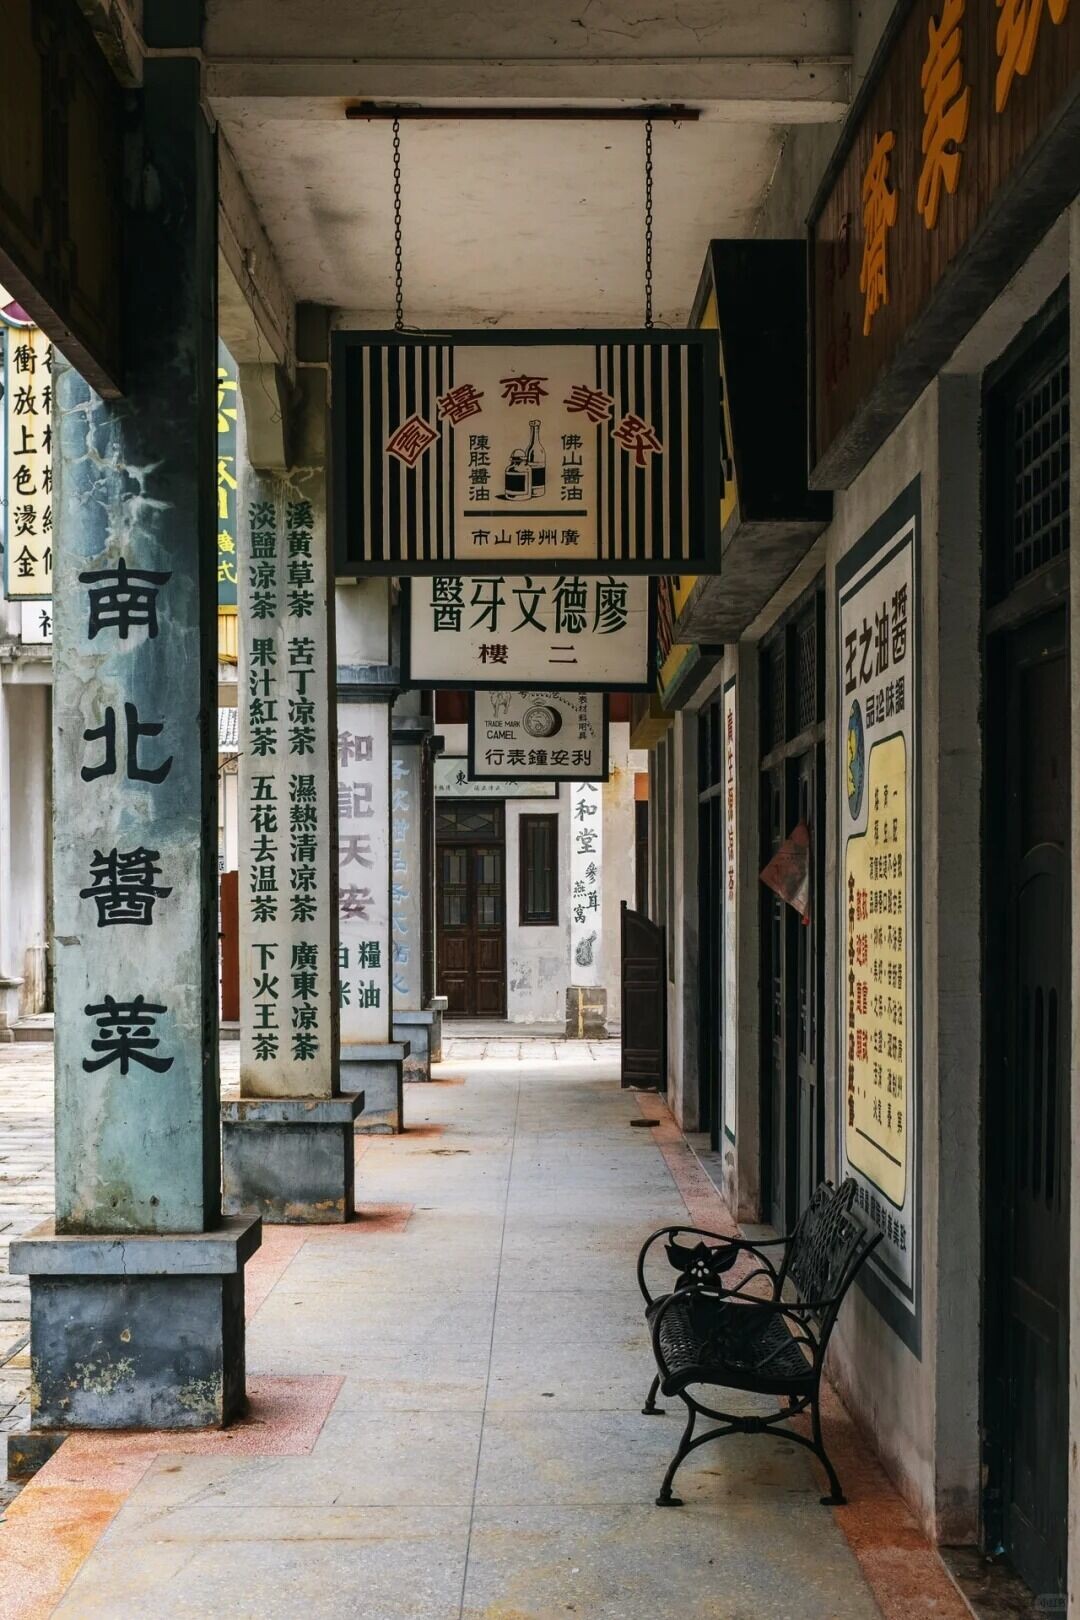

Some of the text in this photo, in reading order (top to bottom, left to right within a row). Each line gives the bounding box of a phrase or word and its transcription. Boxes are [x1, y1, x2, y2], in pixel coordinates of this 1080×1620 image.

[561, 434, 584, 500] 佛山醬油
[471, 529, 580, 546] 廣州佛山市
[478, 644, 578, 664] 二樓
[249, 637, 278, 757] 果汁紅茶
[485, 720, 521, 728] TRADE MARK
[486, 730, 517, 740] CAMEL
[78, 556, 174, 1075] 南北醬菜
[252, 942, 279, 1061] 下火王茶
[358, 941, 381, 1008] 糧油
